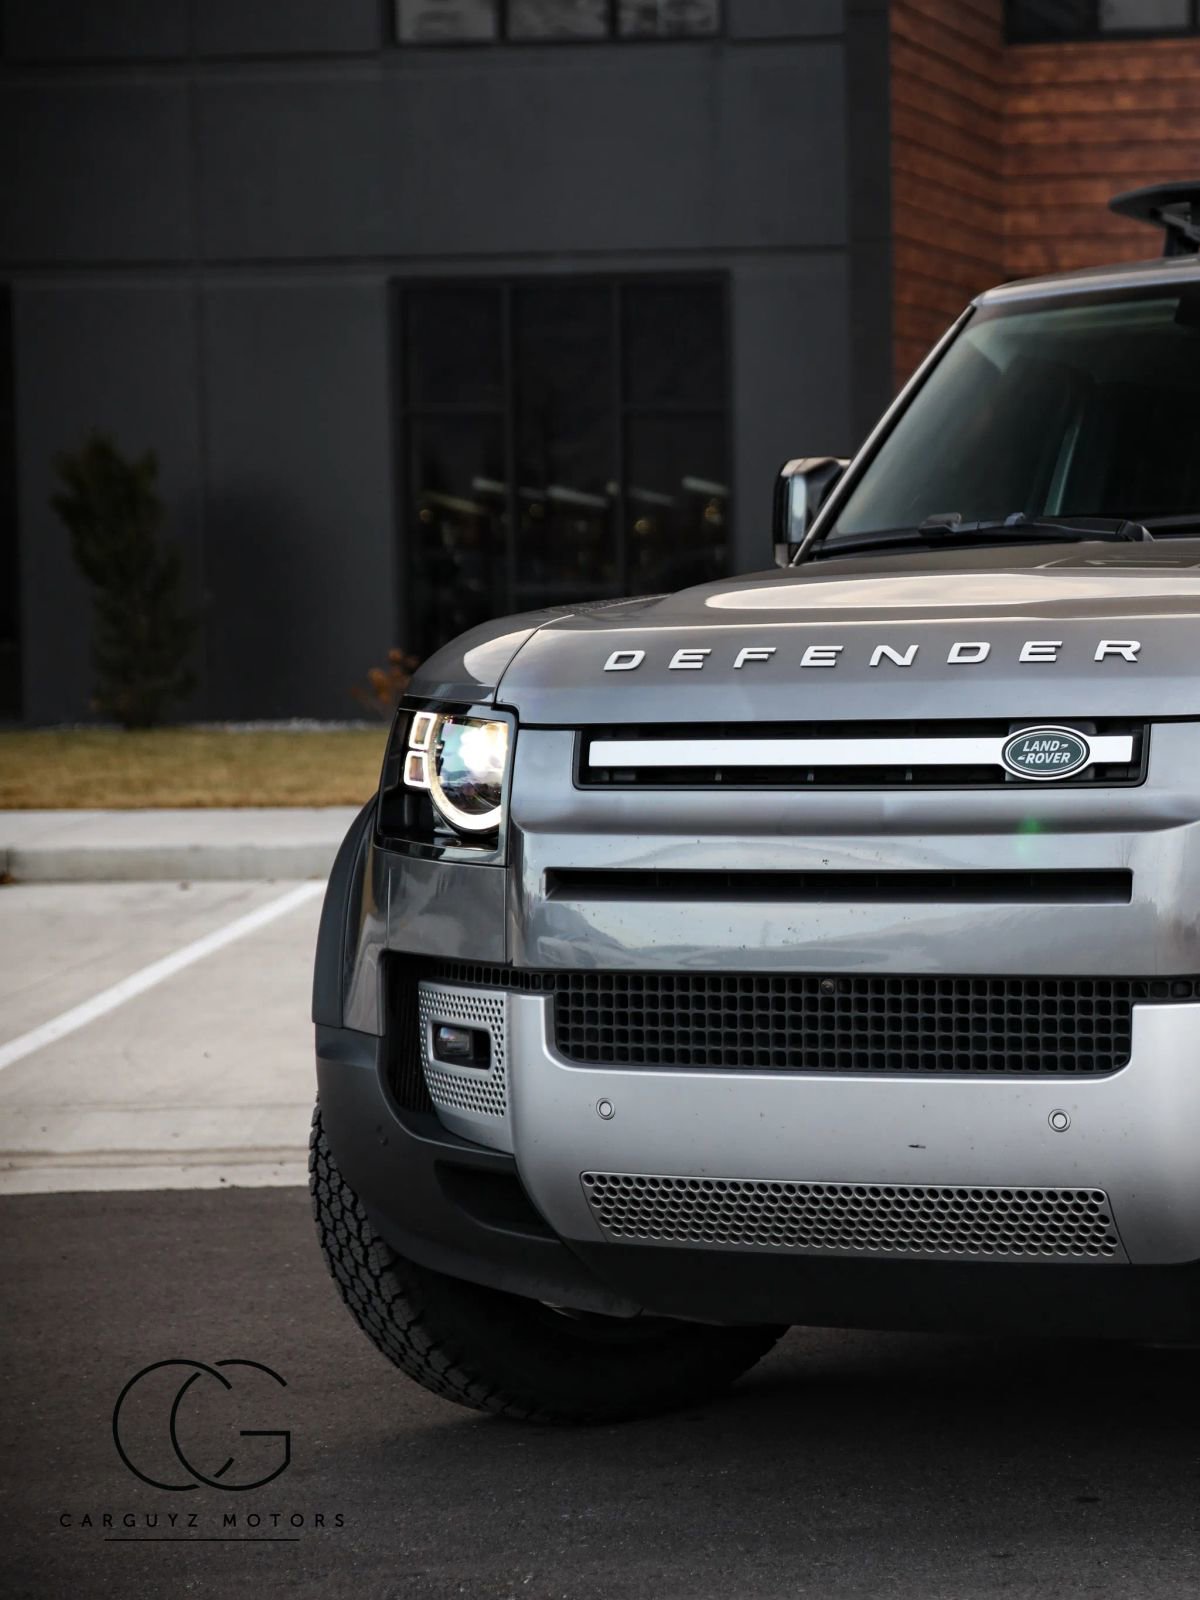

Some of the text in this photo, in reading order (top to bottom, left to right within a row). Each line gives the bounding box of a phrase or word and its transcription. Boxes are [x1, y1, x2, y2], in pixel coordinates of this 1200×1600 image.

[603, 640, 1141, 671] DEFENDER
[1023, 740, 1060, 752] LAND
[1025, 752, 1071, 764] ROVER
